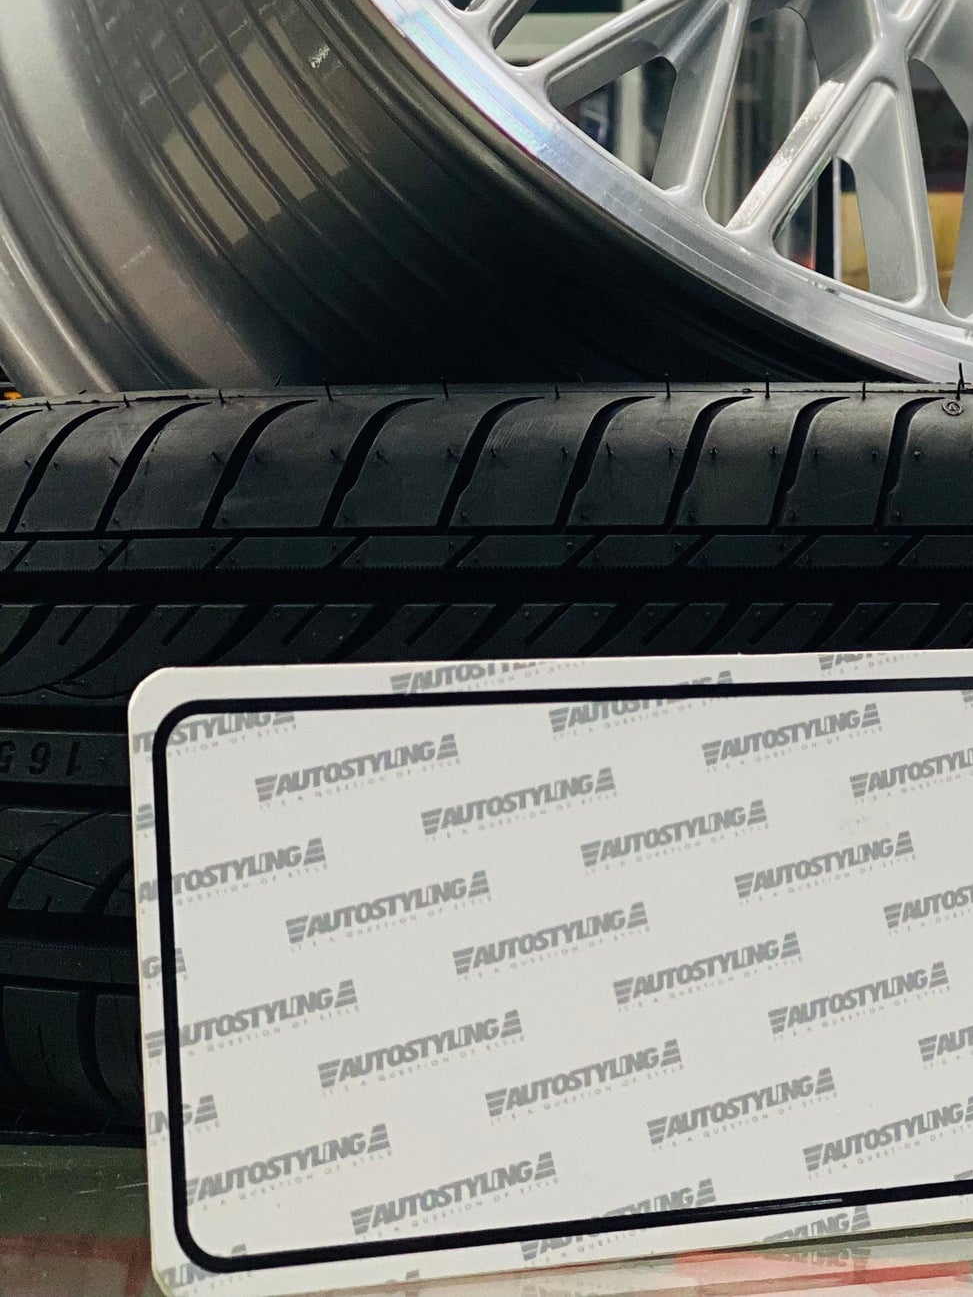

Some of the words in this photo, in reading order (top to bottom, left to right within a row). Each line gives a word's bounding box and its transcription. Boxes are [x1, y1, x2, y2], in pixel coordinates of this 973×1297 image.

[718, 708, 862, 761] AUTOSTYLING
[275, 739, 438, 796] AUTOSTYLING
[439, 773, 596, 830] AUTOSTYLING
[598, 805, 749, 862] AUTOSTYLING
[752, 836, 896, 893] AUTOSTYLING
[306, 876, 470, 938] AUTOSTYLING
[471, 908, 629, 969] AUTOSTYLING
[631, 938, 782, 999] AUTOSTYLING
[786, 968, 931, 1028] AUTOSTYLING
[337, 1016, 502, 1082] AUTOSTYLING
[504, 1046, 662, 1111] AUTOSTYLING
[665, 1074, 817, 1139] AUTOSTYLING
[821, 1101, 966, 1165] AUTOSTYLING
[195, 1131, 369, 1202] AUTOSTYLING
[370, 1159, 536, 1229] AUTOSTYLING
